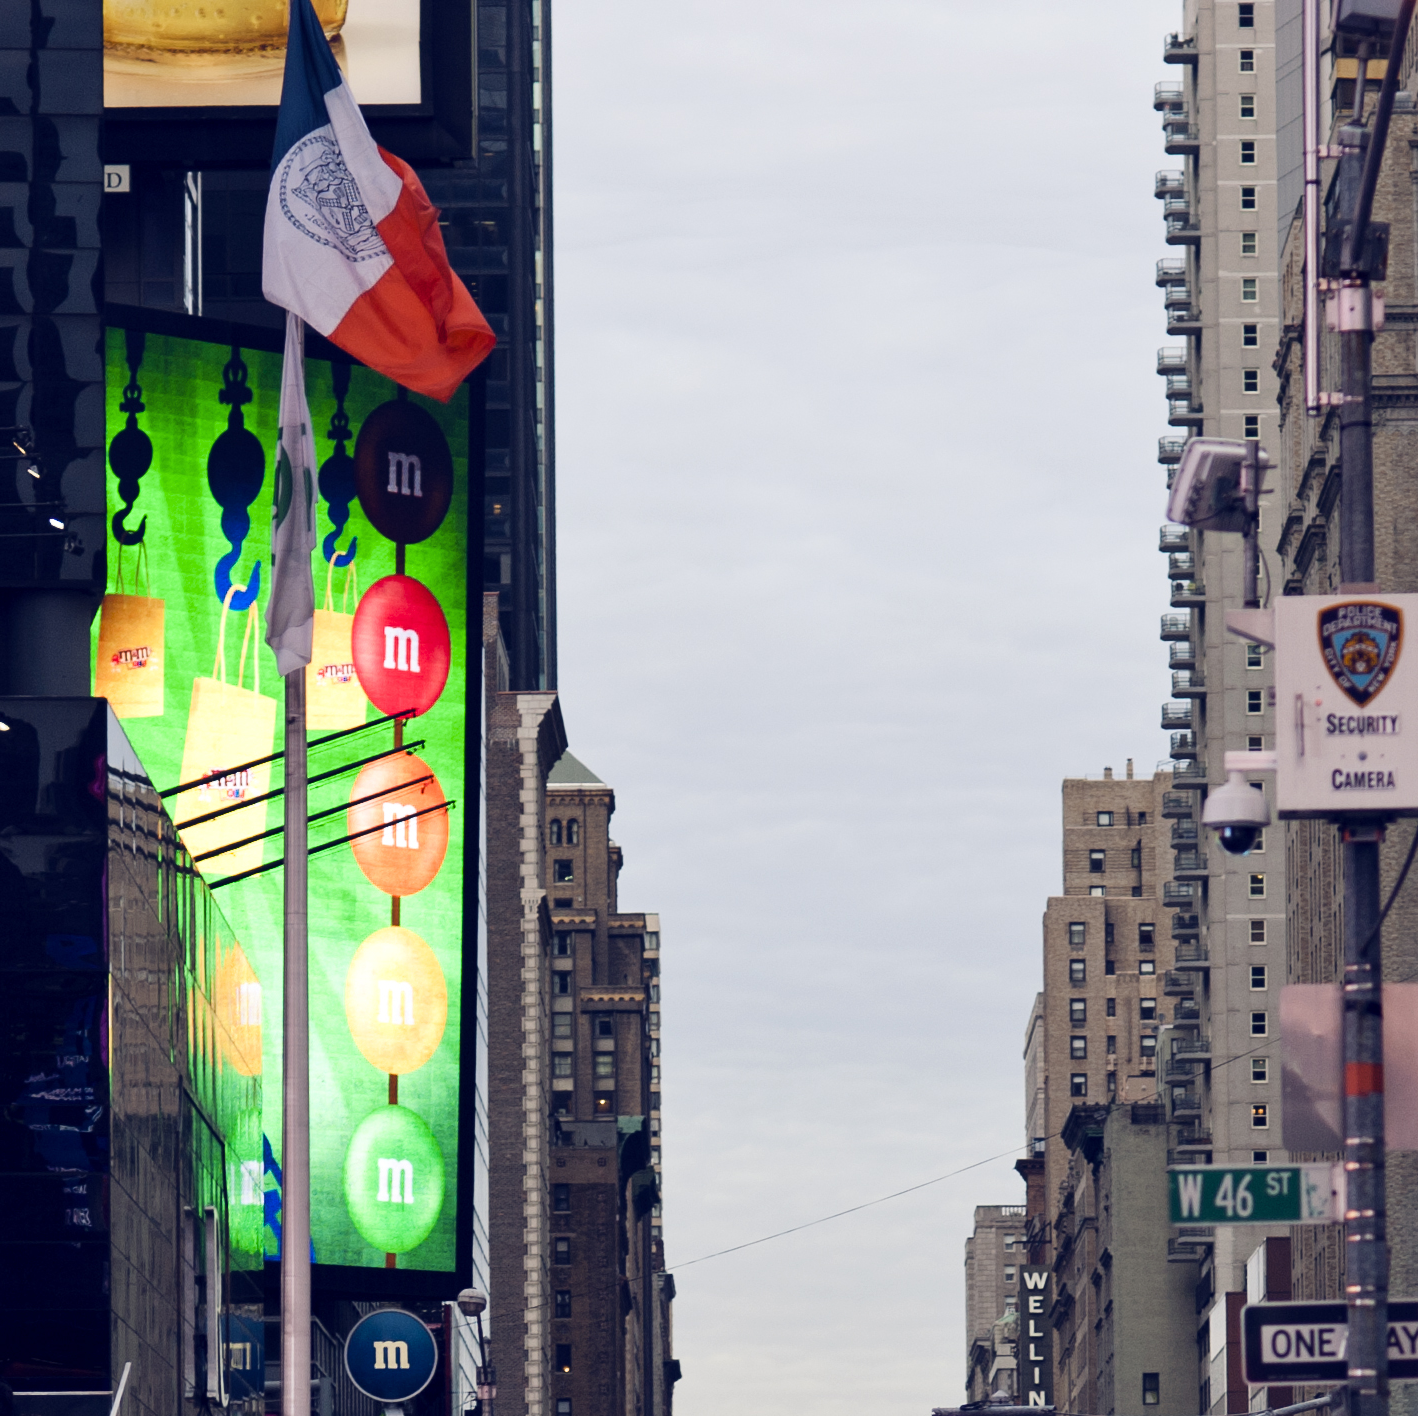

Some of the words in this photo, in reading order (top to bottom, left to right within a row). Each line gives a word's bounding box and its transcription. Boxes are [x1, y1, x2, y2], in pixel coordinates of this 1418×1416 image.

[1338, 605, 1383, 618] POLICE
[1326, 713, 1399, 735] SECURITY
[1331, 769, 1396, 790] CAMERA
[1178, 1173, 1203, 1218] W
[1215, 1173, 1253, 1217] 46
[1266, 1171, 1292, 1196] ST
[1271, 1328, 1336, 1358] ONE
